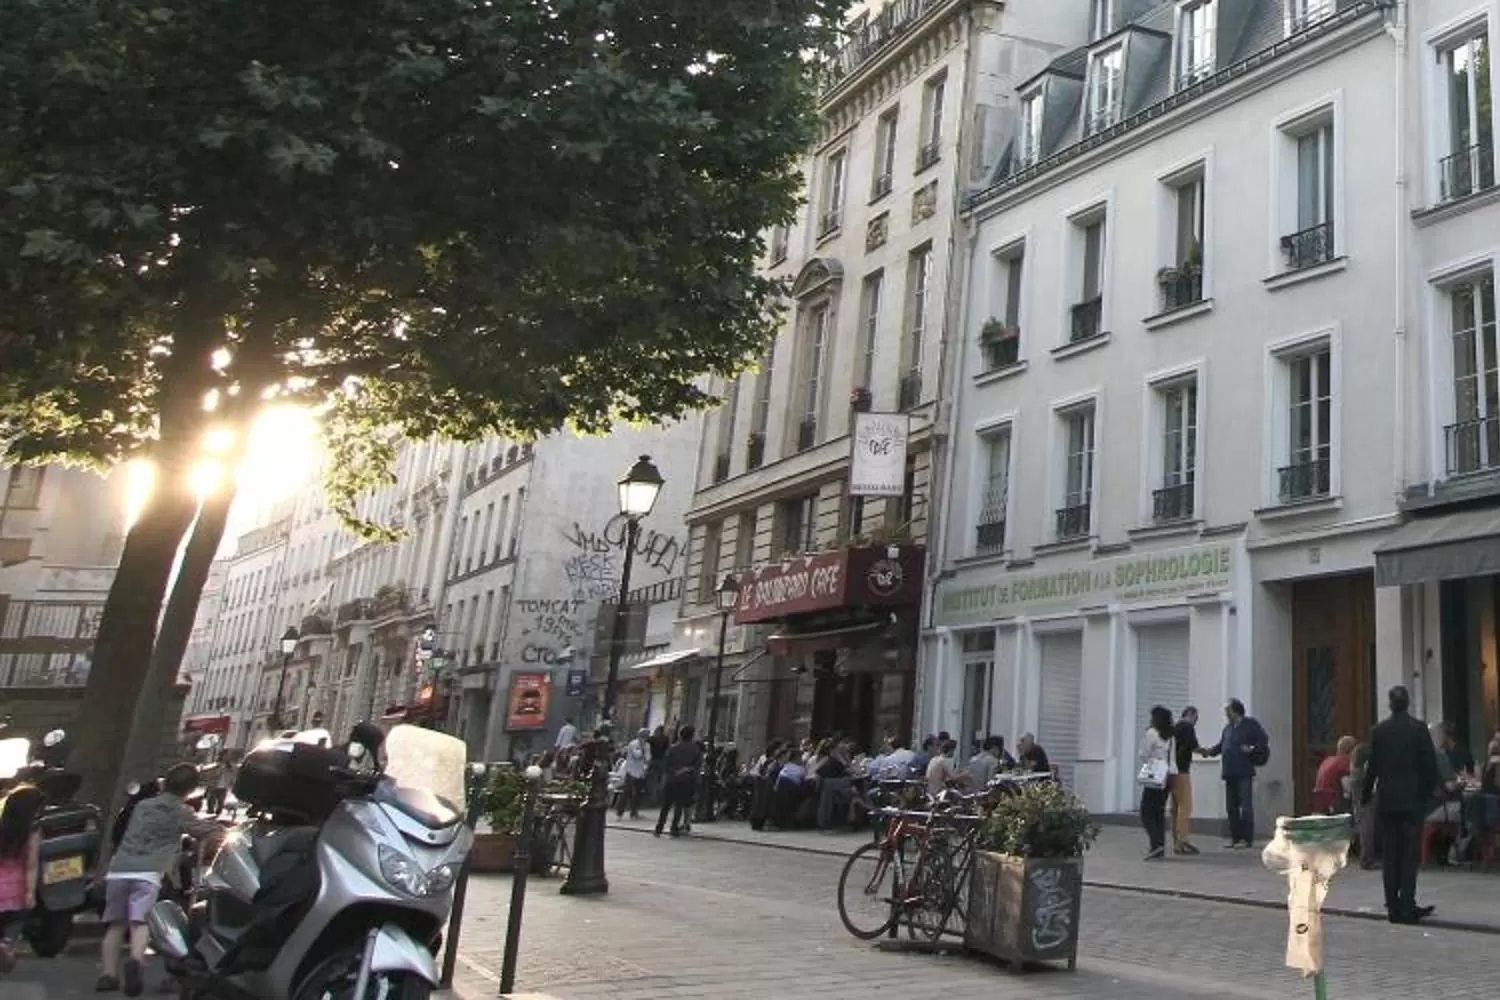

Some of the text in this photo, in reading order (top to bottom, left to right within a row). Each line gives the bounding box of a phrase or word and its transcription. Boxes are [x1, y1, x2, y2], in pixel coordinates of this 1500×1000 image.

[943, 583, 997, 611] TITUT
[1012, 568, 1091, 601] FORMATION
[1115, 548, 1230, 586] SOPHROLOGIE
